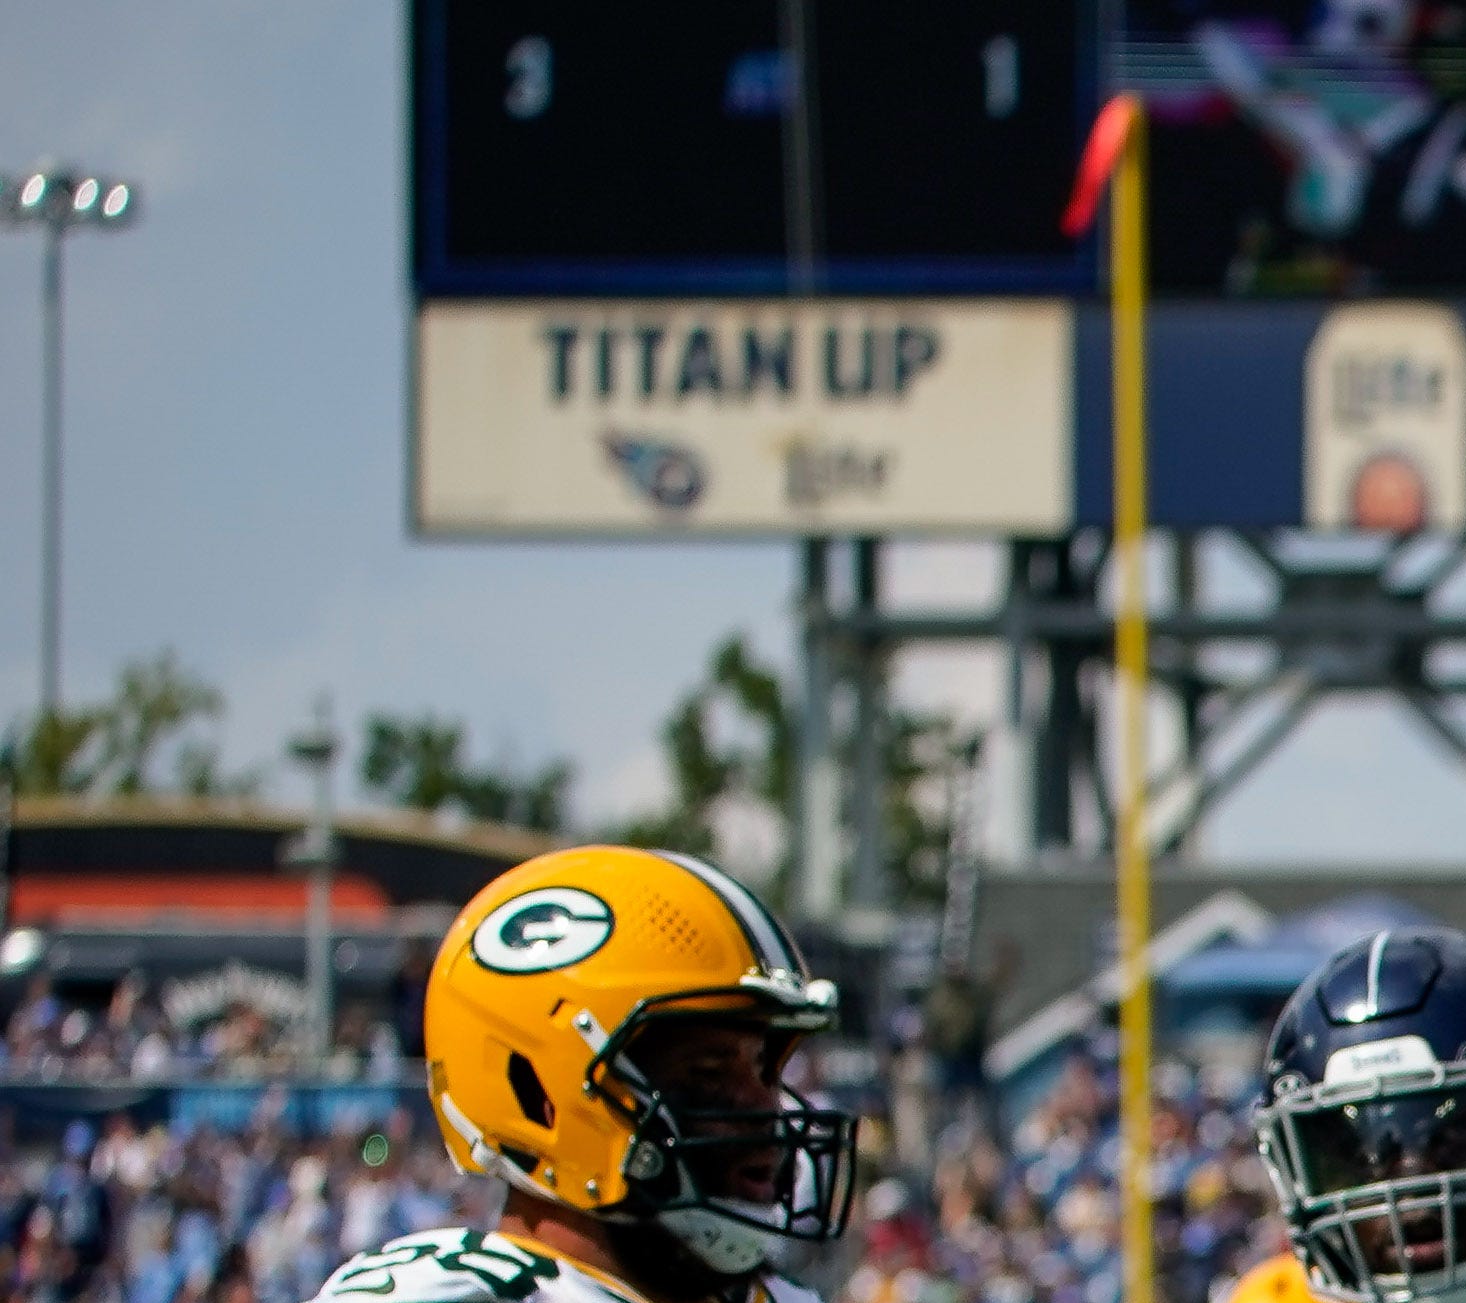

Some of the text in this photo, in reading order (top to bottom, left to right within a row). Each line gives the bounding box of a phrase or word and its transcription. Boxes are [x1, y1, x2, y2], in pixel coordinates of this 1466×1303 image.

[544, 322, 940, 403] TITAN UP
[471, 886, 615, 974] G
